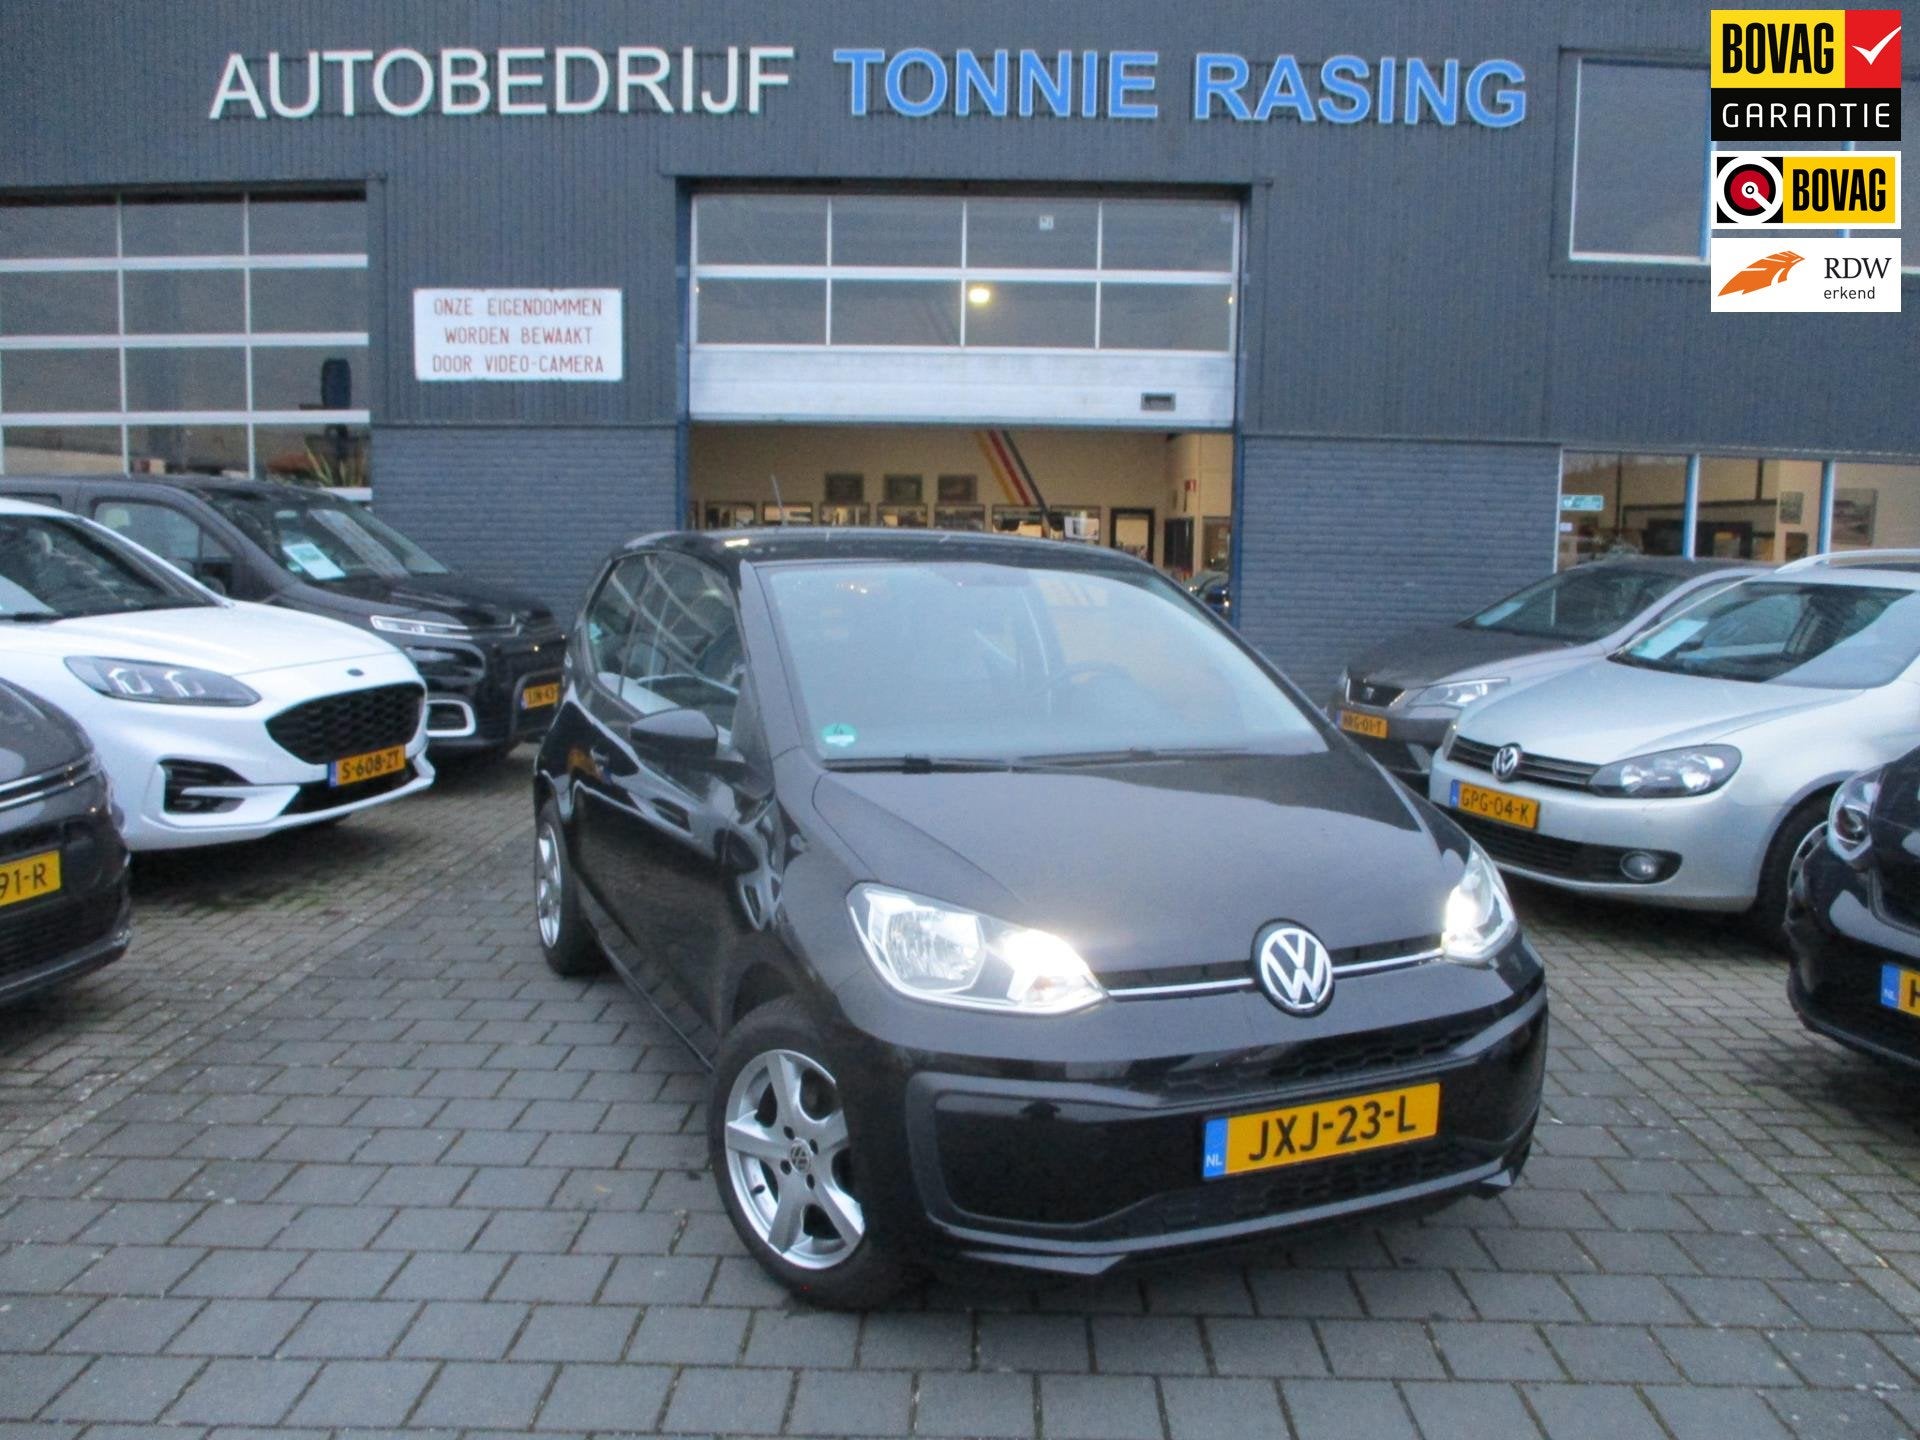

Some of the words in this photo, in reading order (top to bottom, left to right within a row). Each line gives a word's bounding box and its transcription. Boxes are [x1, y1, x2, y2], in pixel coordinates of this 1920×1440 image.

[208, 46, 795, 120] AUTOBEDRIJF
[833, 47, 1159, 118] TONNIE
[1194, 52, 1527, 127] RASING
[433, 297, 473, 316] ONZE
[487, 298, 602, 316] EIGENDOMMEN
[444, 326, 510, 345] WORDEN
[521, 326, 593, 345] BEWAAKT
[432, 355, 473, 373] DOOR
[485, 355, 604, 373] VIDEO-CAMERA
[1461, 787, 1530, 824] GPG-04-K
[1248, 1095, 1417, 1162] JXJ-23-L
[1205, 1153, 1223, 1168] NL
